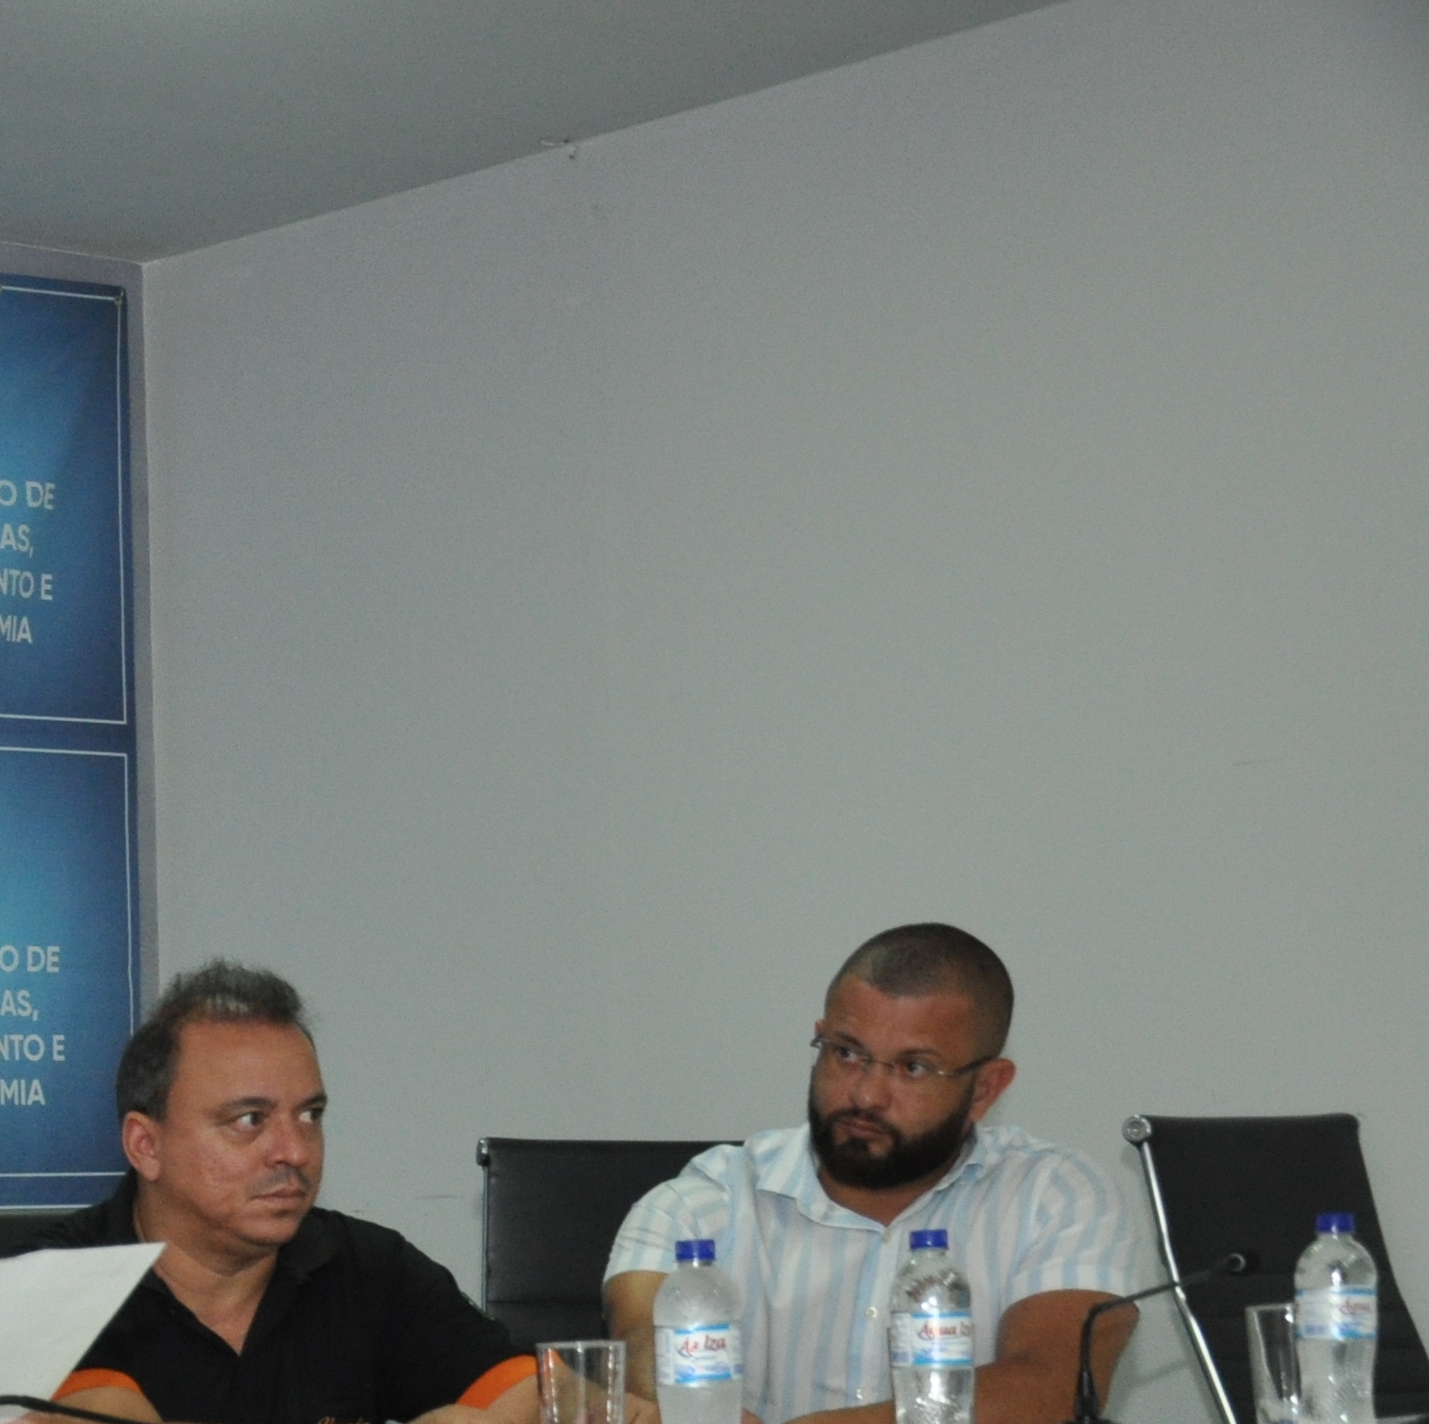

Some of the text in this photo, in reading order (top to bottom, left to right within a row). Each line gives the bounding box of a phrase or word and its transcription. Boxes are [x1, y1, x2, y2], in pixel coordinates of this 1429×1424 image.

[25, 480, 56, 511] DE
[40, 573, 53, 601] E
[27, 945, 60, 974] DE
[52, 1034, 65, 1062] E
